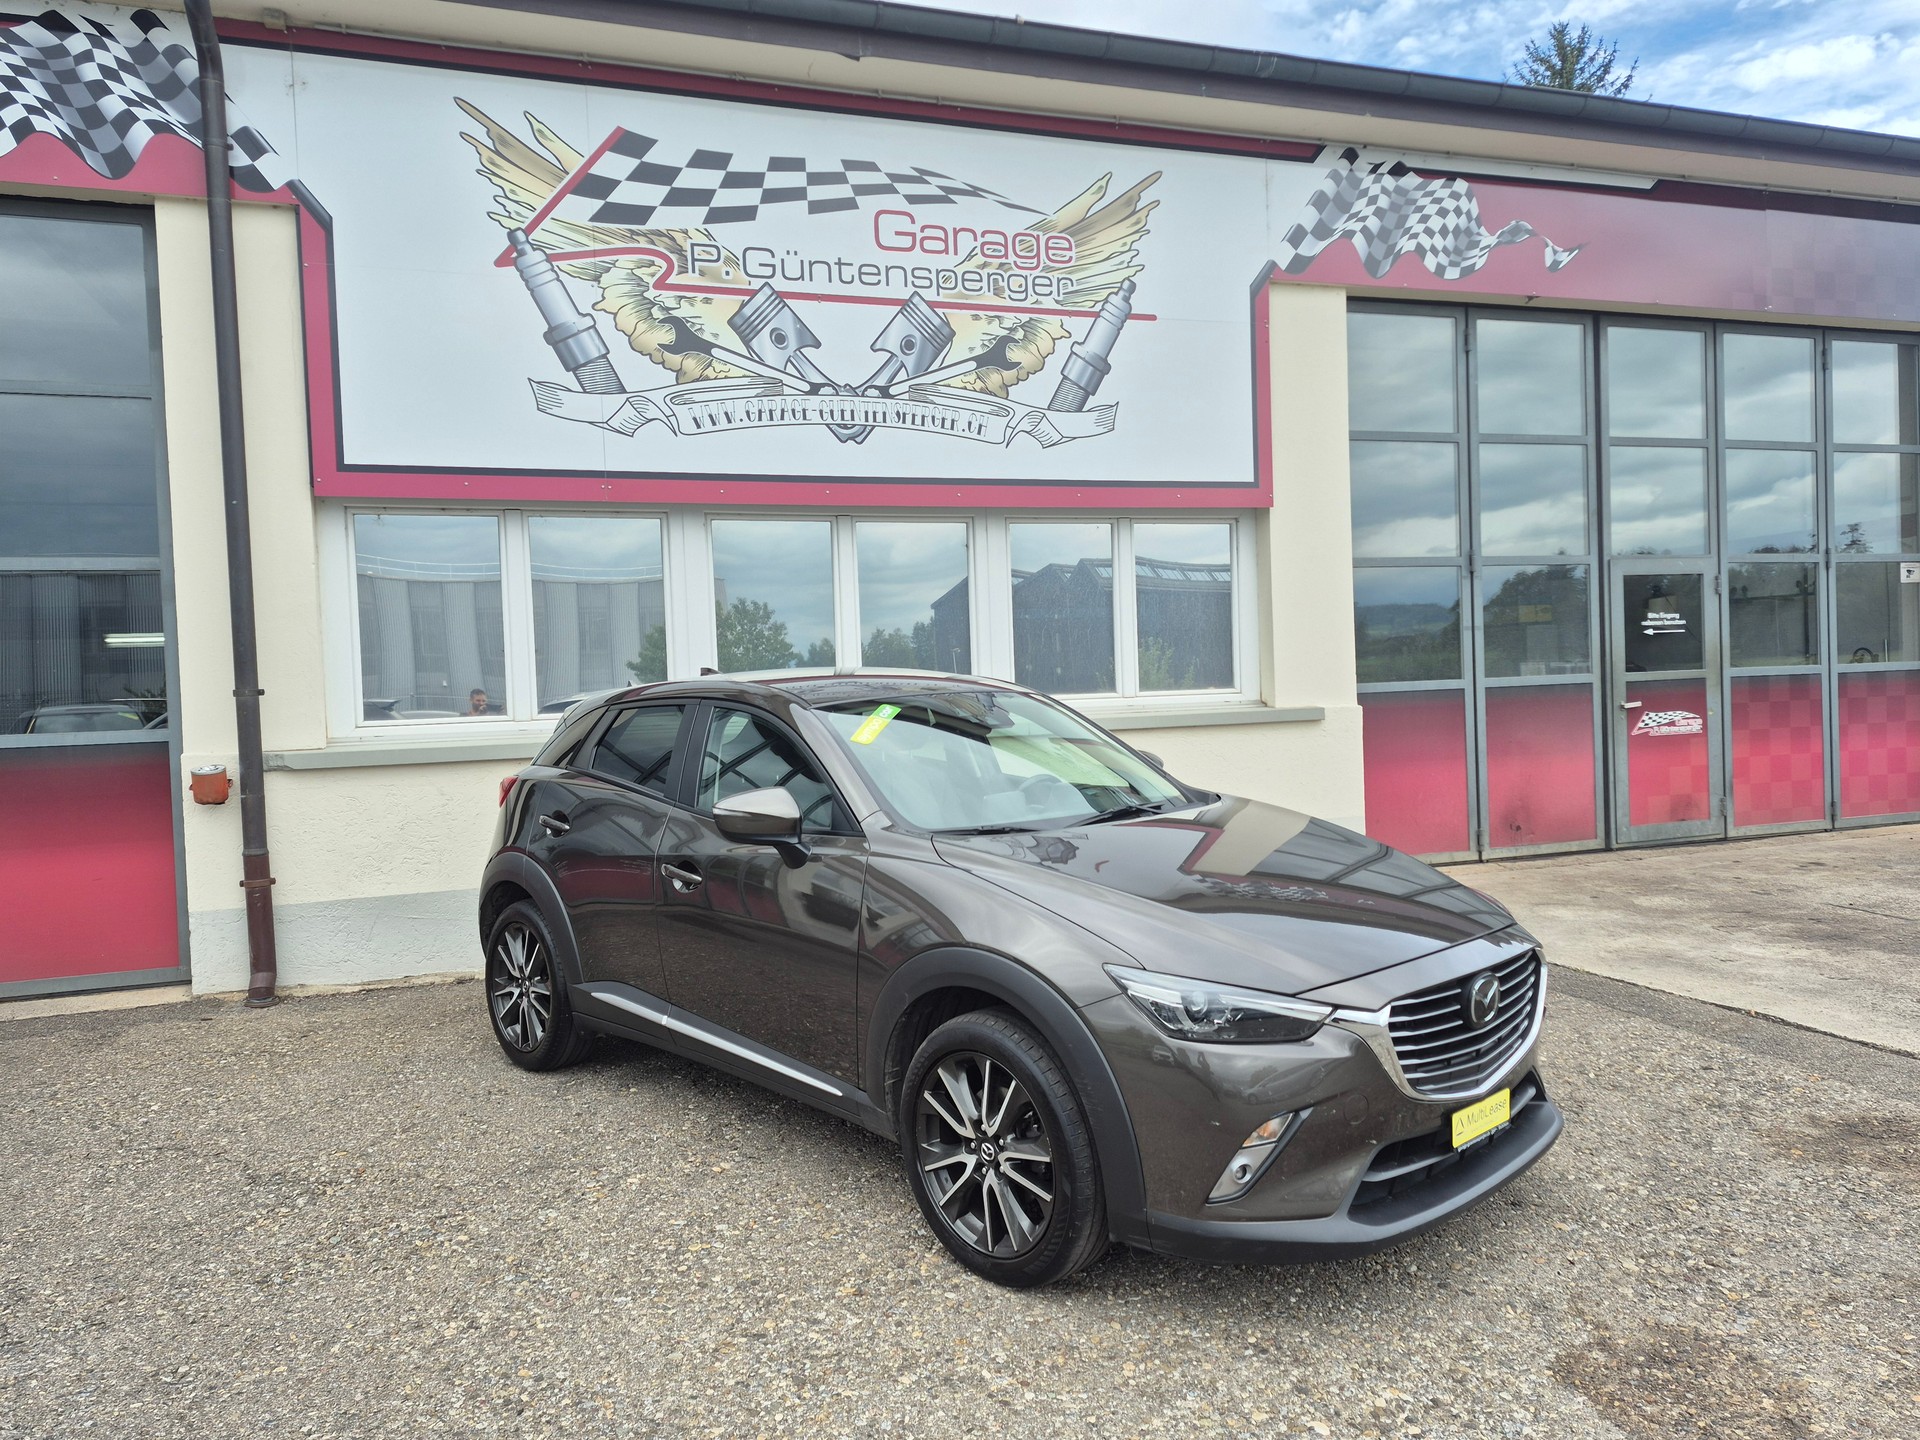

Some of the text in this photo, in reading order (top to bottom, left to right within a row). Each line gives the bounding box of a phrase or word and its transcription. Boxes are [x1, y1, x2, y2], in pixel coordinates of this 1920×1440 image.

[873, 209, 1074, 271] Garage
[690, 242, 1075, 302] P. Güntensperger
[687, 398, 990, 438] WWW.GARAGE-GUENTENSPERGER.CH
[1466, 1098, 1508, 1128] MultiLease
